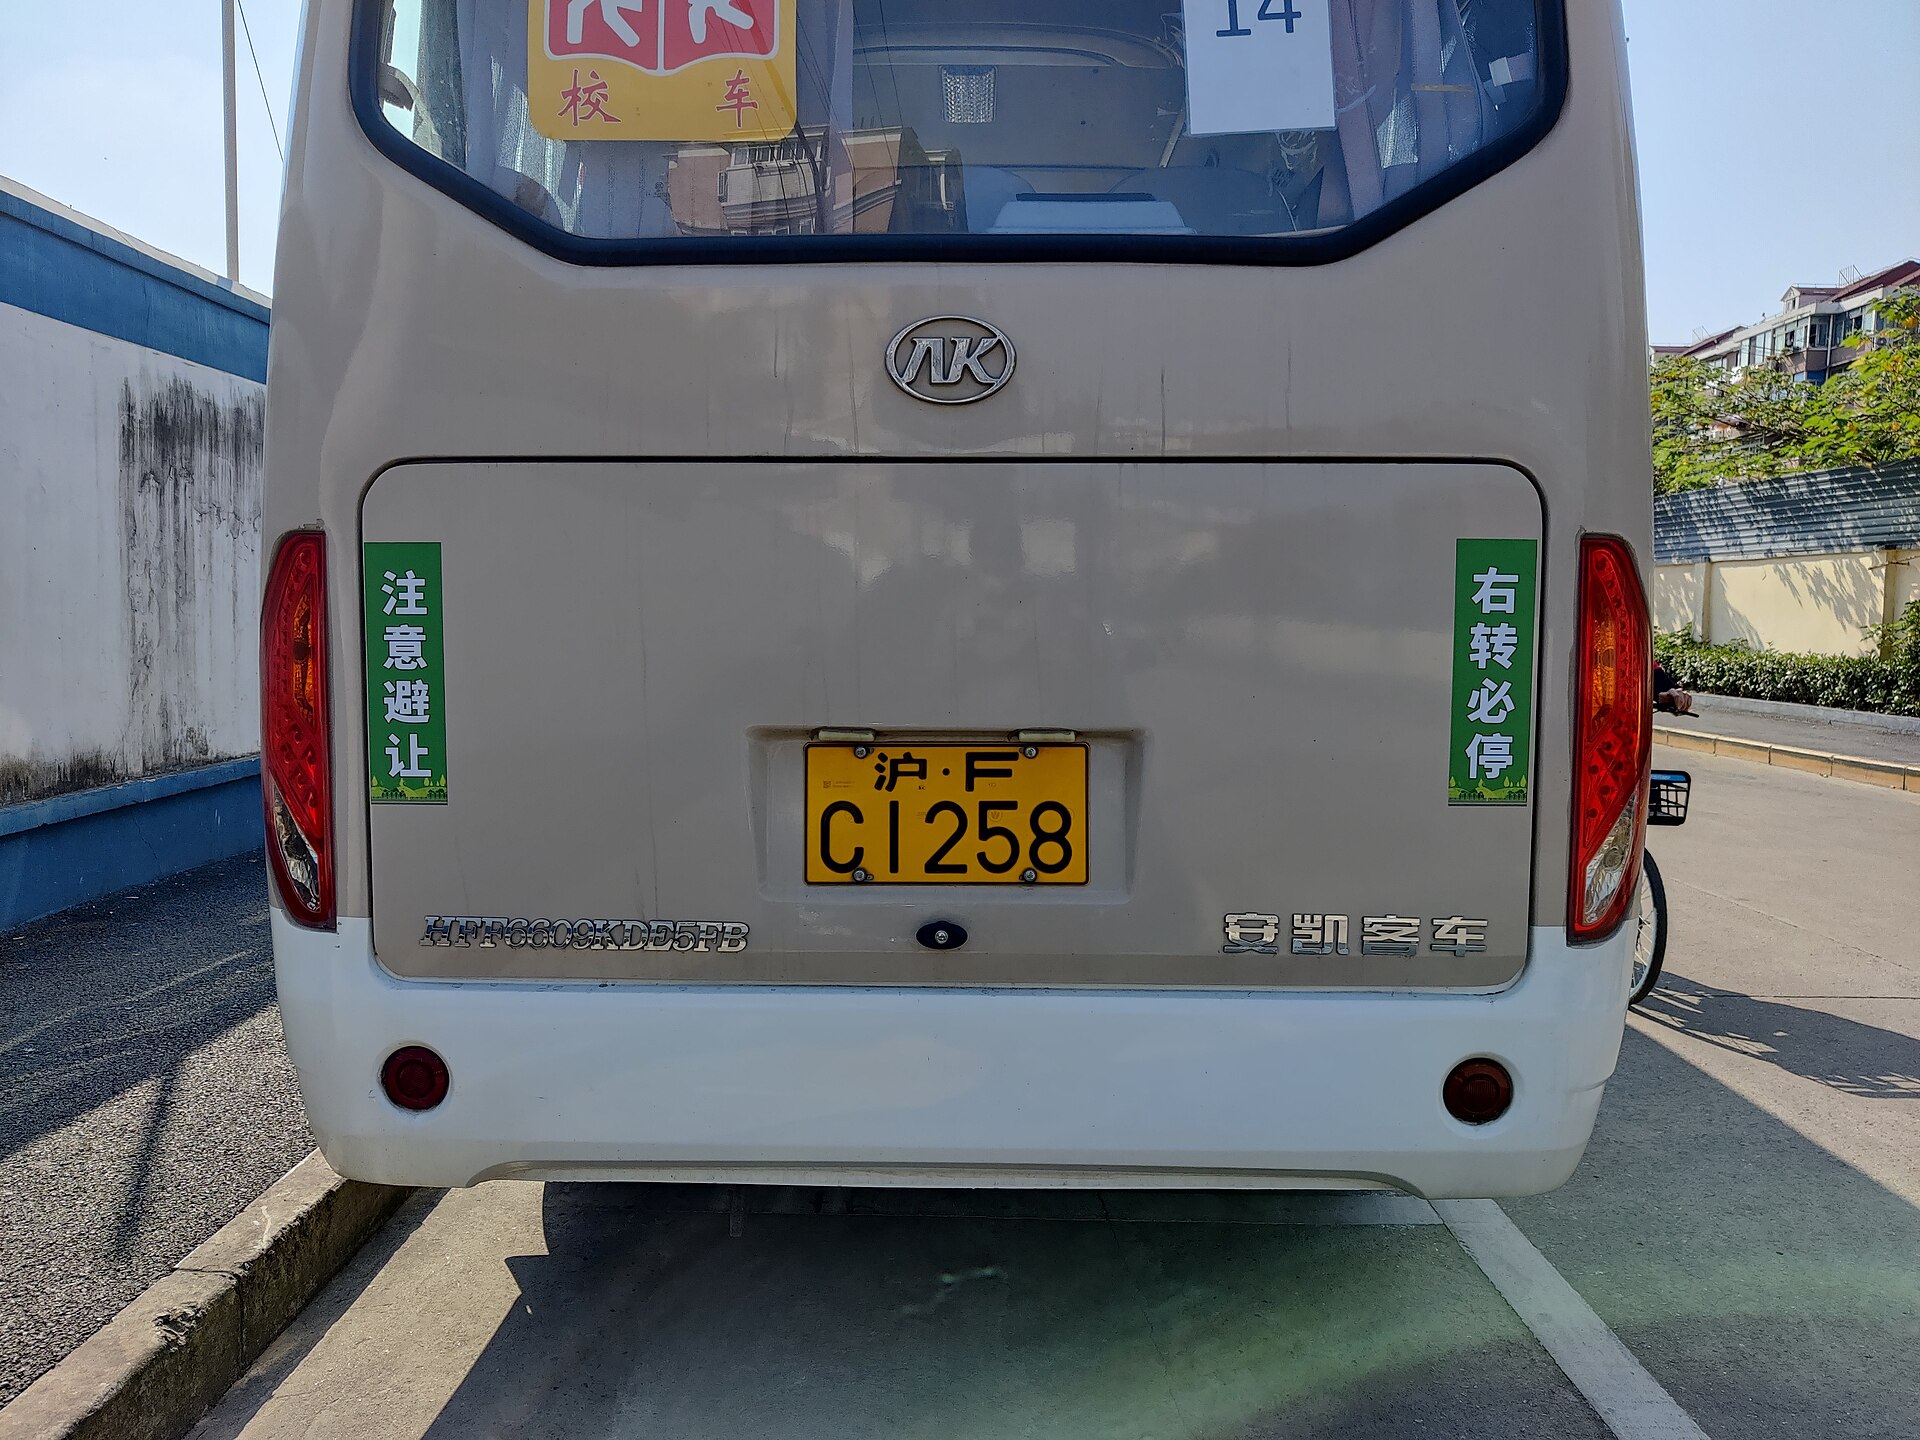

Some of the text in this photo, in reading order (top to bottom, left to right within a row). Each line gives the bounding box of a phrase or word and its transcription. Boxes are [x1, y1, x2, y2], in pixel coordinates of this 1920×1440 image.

[557, 67, 759, 128] 校车
[380, 569, 433, 778] 注意避让
[1465, 566, 1519, 780] 右转必停
[820, 800, 1073, 874] C1258
[418, 914, 751, 953] HFF6609KDE5FB
[1222, 911, 1489, 957] 安凯客车
